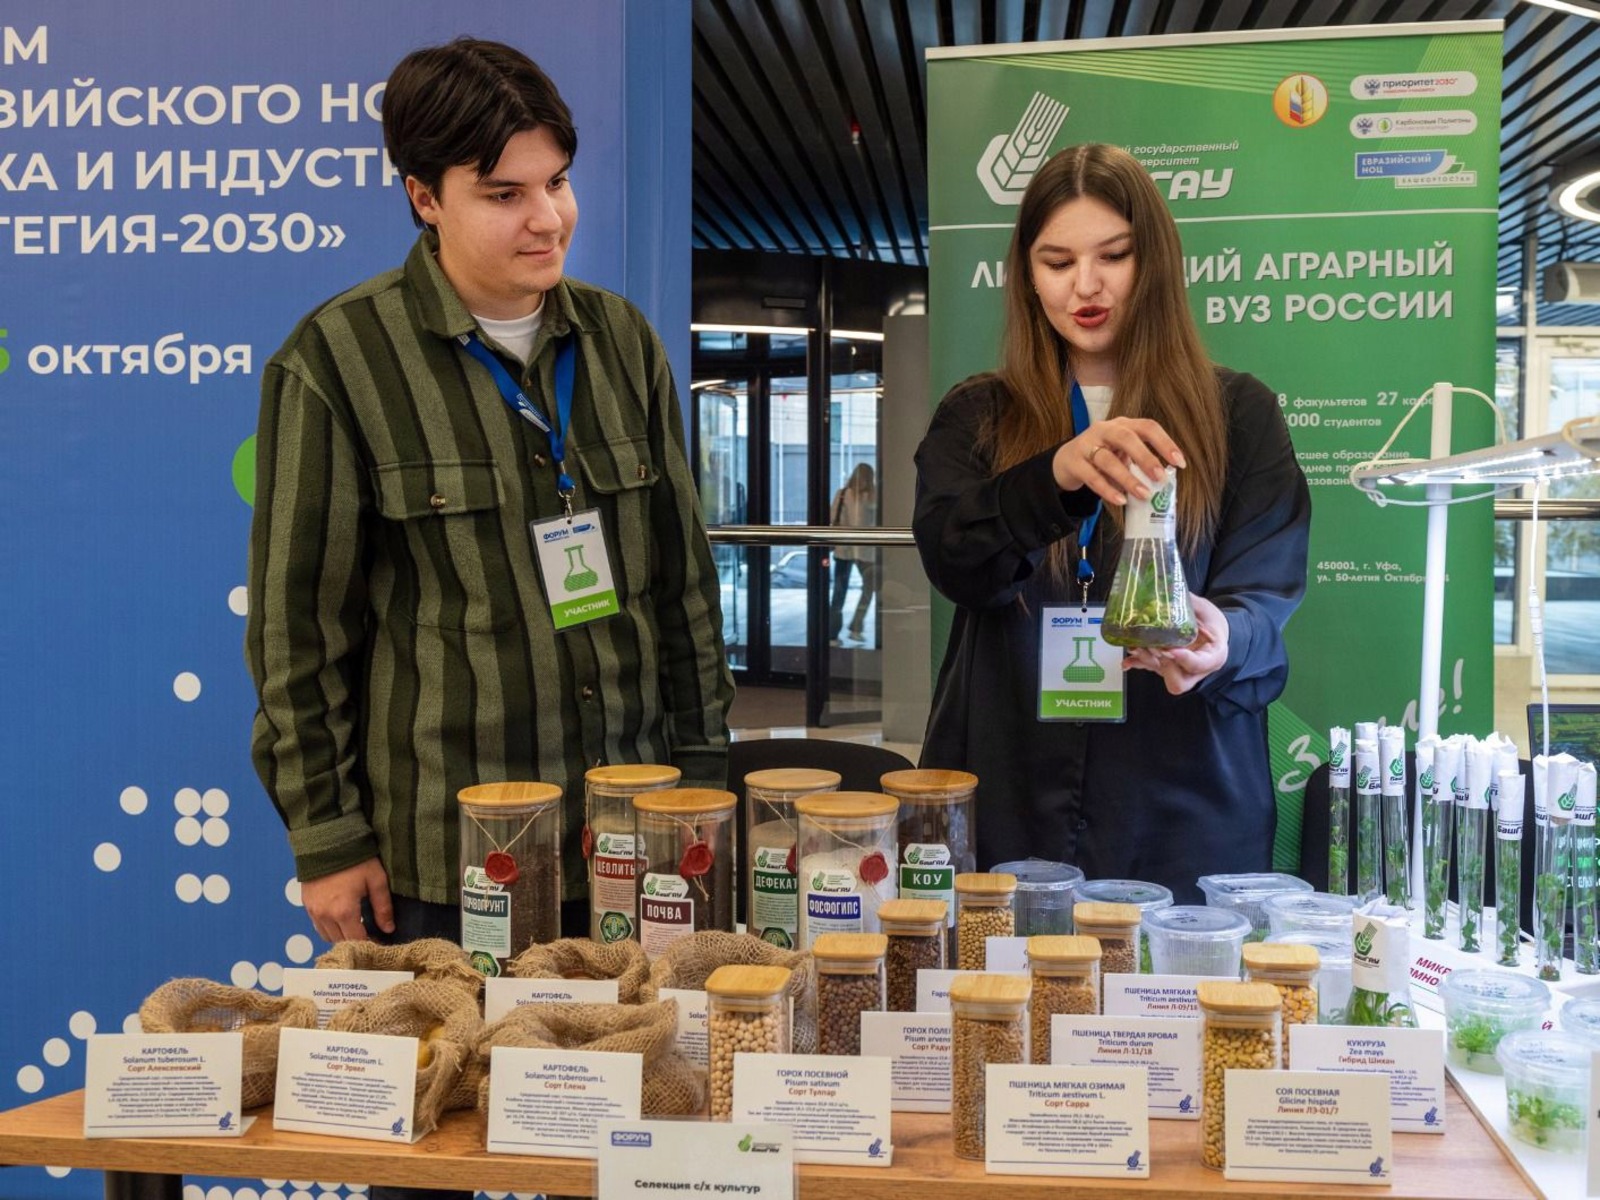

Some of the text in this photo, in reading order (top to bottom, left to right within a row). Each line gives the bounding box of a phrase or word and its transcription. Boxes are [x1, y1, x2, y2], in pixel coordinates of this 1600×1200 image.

[1134, 140, 1239, 155] государственный
[1138, 157, 1200, 168] верситет
[1361, 154, 1432, 166] ЕВРАЗИЙСКИЙ
[77, 152, 113, 191] И
[1361, 166, 1384, 174] НОЦ
[1254, 240, 1454, 282] АГРАРНЫЙ
[1206, 290, 1454, 325] ВУЗ РОССИИ
[27, 333, 252, 384] октября
[1293, 397, 1368, 409] факультетов
[1377, 392, 1398, 406] 27
[1284, 412, 1382, 429] 000 студентов
[543, 529, 569, 541] ФОРУМ
[1375, 561, 1402, 572] Уфа,
[1335, 573, 1380, 582] 50-летия
[564, 599, 610, 617] УЧАСТНИК
[1055, 699, 1112, 708] УЧАСТНИК
[755, 875, 797, 890] ДЕФЕКАТ
[912, 873, 943, 885] КОУ
[647, 904, 682, 920] ПОЧВА
[809, 899, 858, 915] ФОСФОГИПС
[531, 992, 572, 1000] КАРТОФЕЛЬ
[1124, 987, 1161, 995] ПШЕНИЦА
[1162, 988, 1191, 996] МЯГКАЯ
[903, 1026, 927, 1034] ГОРОХ
[1072, 1029, 1178, 1040] ПШЕНИЦА ТВЕРДАЯ ЯРОВАЯ
[912, 1043, 929, 1051] Сорт
[1098, 1038, 1154, 1047] Triticum durum
[1346, 1039, 1386, 1048] КУКУРУЗА
[141, 1047, 188, 1055] КАРТОФЕЛЬ
[326, 1045, 369, 1056] КАРТОФЕЛЬ
[123, 1056, 156, 1064] Solanum
[157, 1055, 198, 1063] tuberosum
[309, 1052, 339, 1062] Solanum
[340, 1055, 377, 1065] tuberosum
[1338, 1056, 1367, 1065] Гибрид
[127, 1064, 146, 1072] Сорт
[327, 1062, 343, 1072] Сорт
[543, 1064, 589, 1073] КАРТОФЕЛЬ
[525, 1072, 557, 1081] Solanum
[558, 1074, 598, 1082] tuberosum
[777, 1069, 849, 1079] ГОРОХ ПОСЕВНОЙ
[544, 1081, 587, 1090] Сорт Елена
[785, 1079, 840, 1087] Pisum sativum
[1009, 1081, 1125, 1090] ПШЕНИЦА МЯГКАЯ ОЗИМАЯ
[788, 1088, 836, 1097] Сорт Тулпар
[1029, 1090, 1060, 1098] Triticum
[1061, 1091, 1098, 1099] aestivum
[1275, 1087, 1340, 1097] СОЯ ПОСЕВНАЯ
[1044, 1100, 1090, 1109] Сорт Сарра
[1279, 1097, 1337, 1106] Glicine hispida
[1277, 1106, 1304, 1114] Линия
[612, 1133, 650, 1142] ФОРУМ
[634, 1179, 761, 1194] Селекция с/х культур
